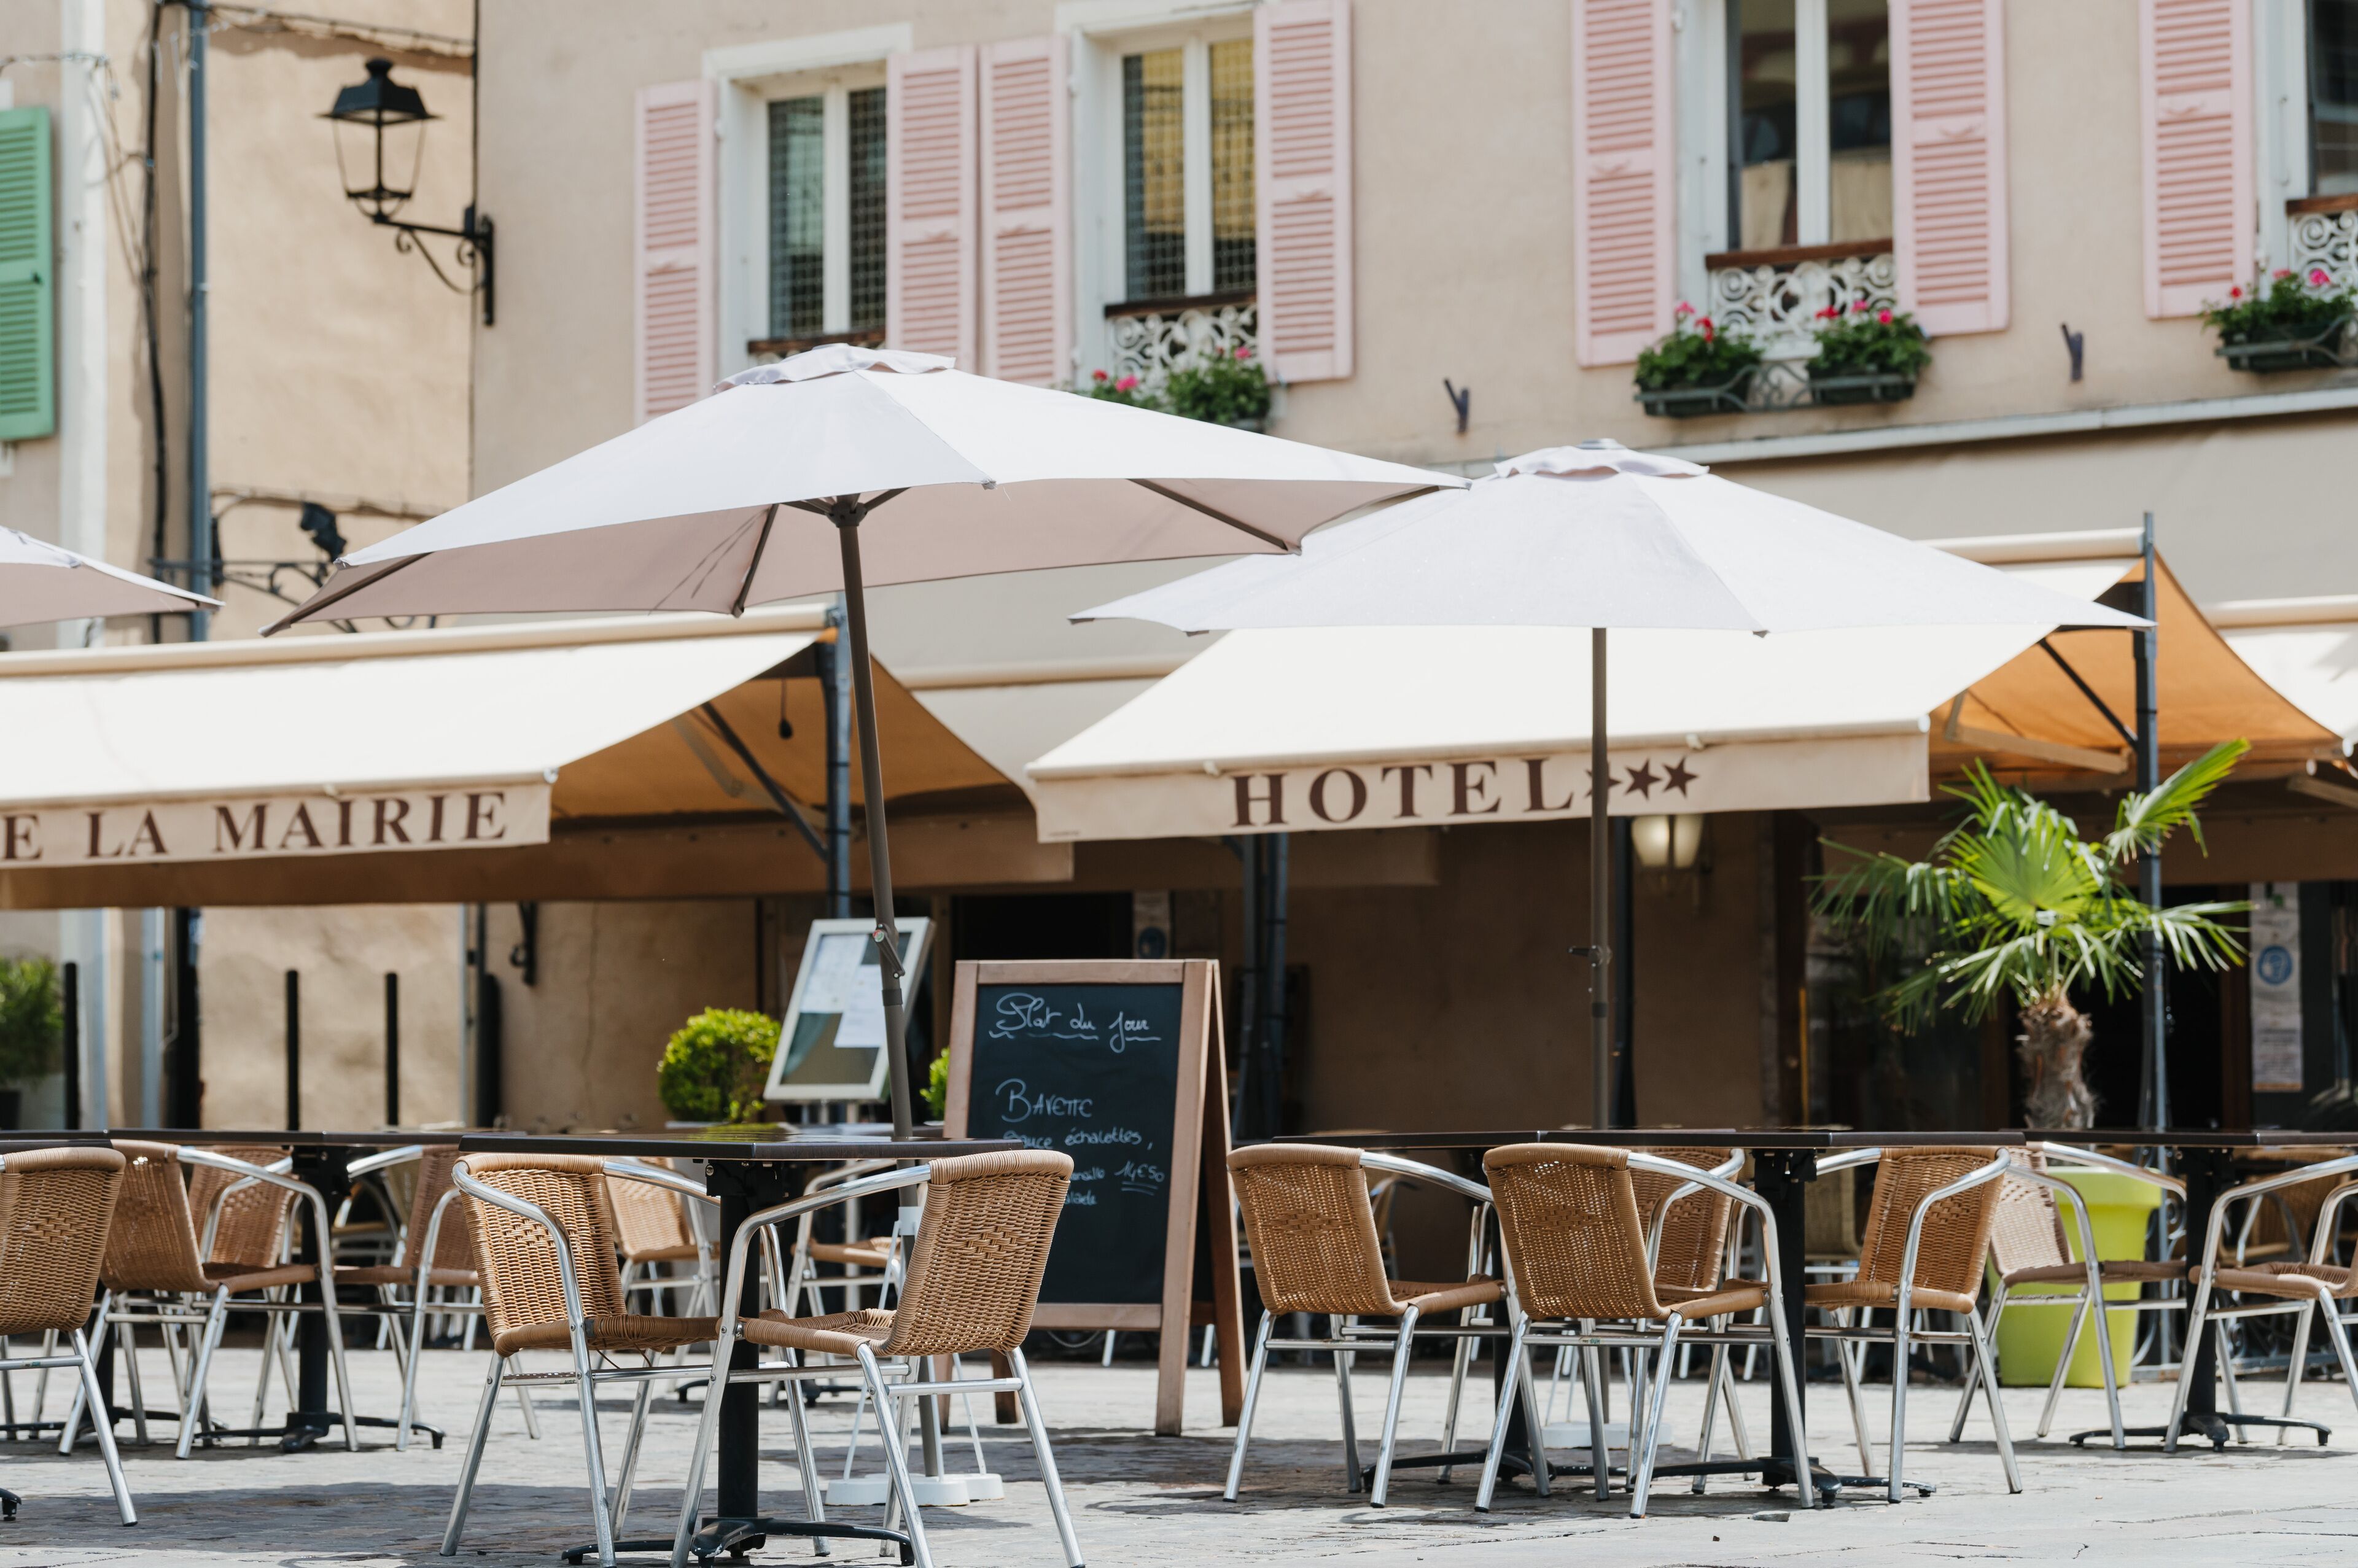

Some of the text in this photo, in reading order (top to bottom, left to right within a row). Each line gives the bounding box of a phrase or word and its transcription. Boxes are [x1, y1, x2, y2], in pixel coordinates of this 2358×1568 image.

[2, 791, 508, 860] E LA MAIRIE
[1230, 756, 1574, 827] HOTEL
[995, 992, 1062, 1031] Plat
[1069, 1002, 1097, 1031] du
